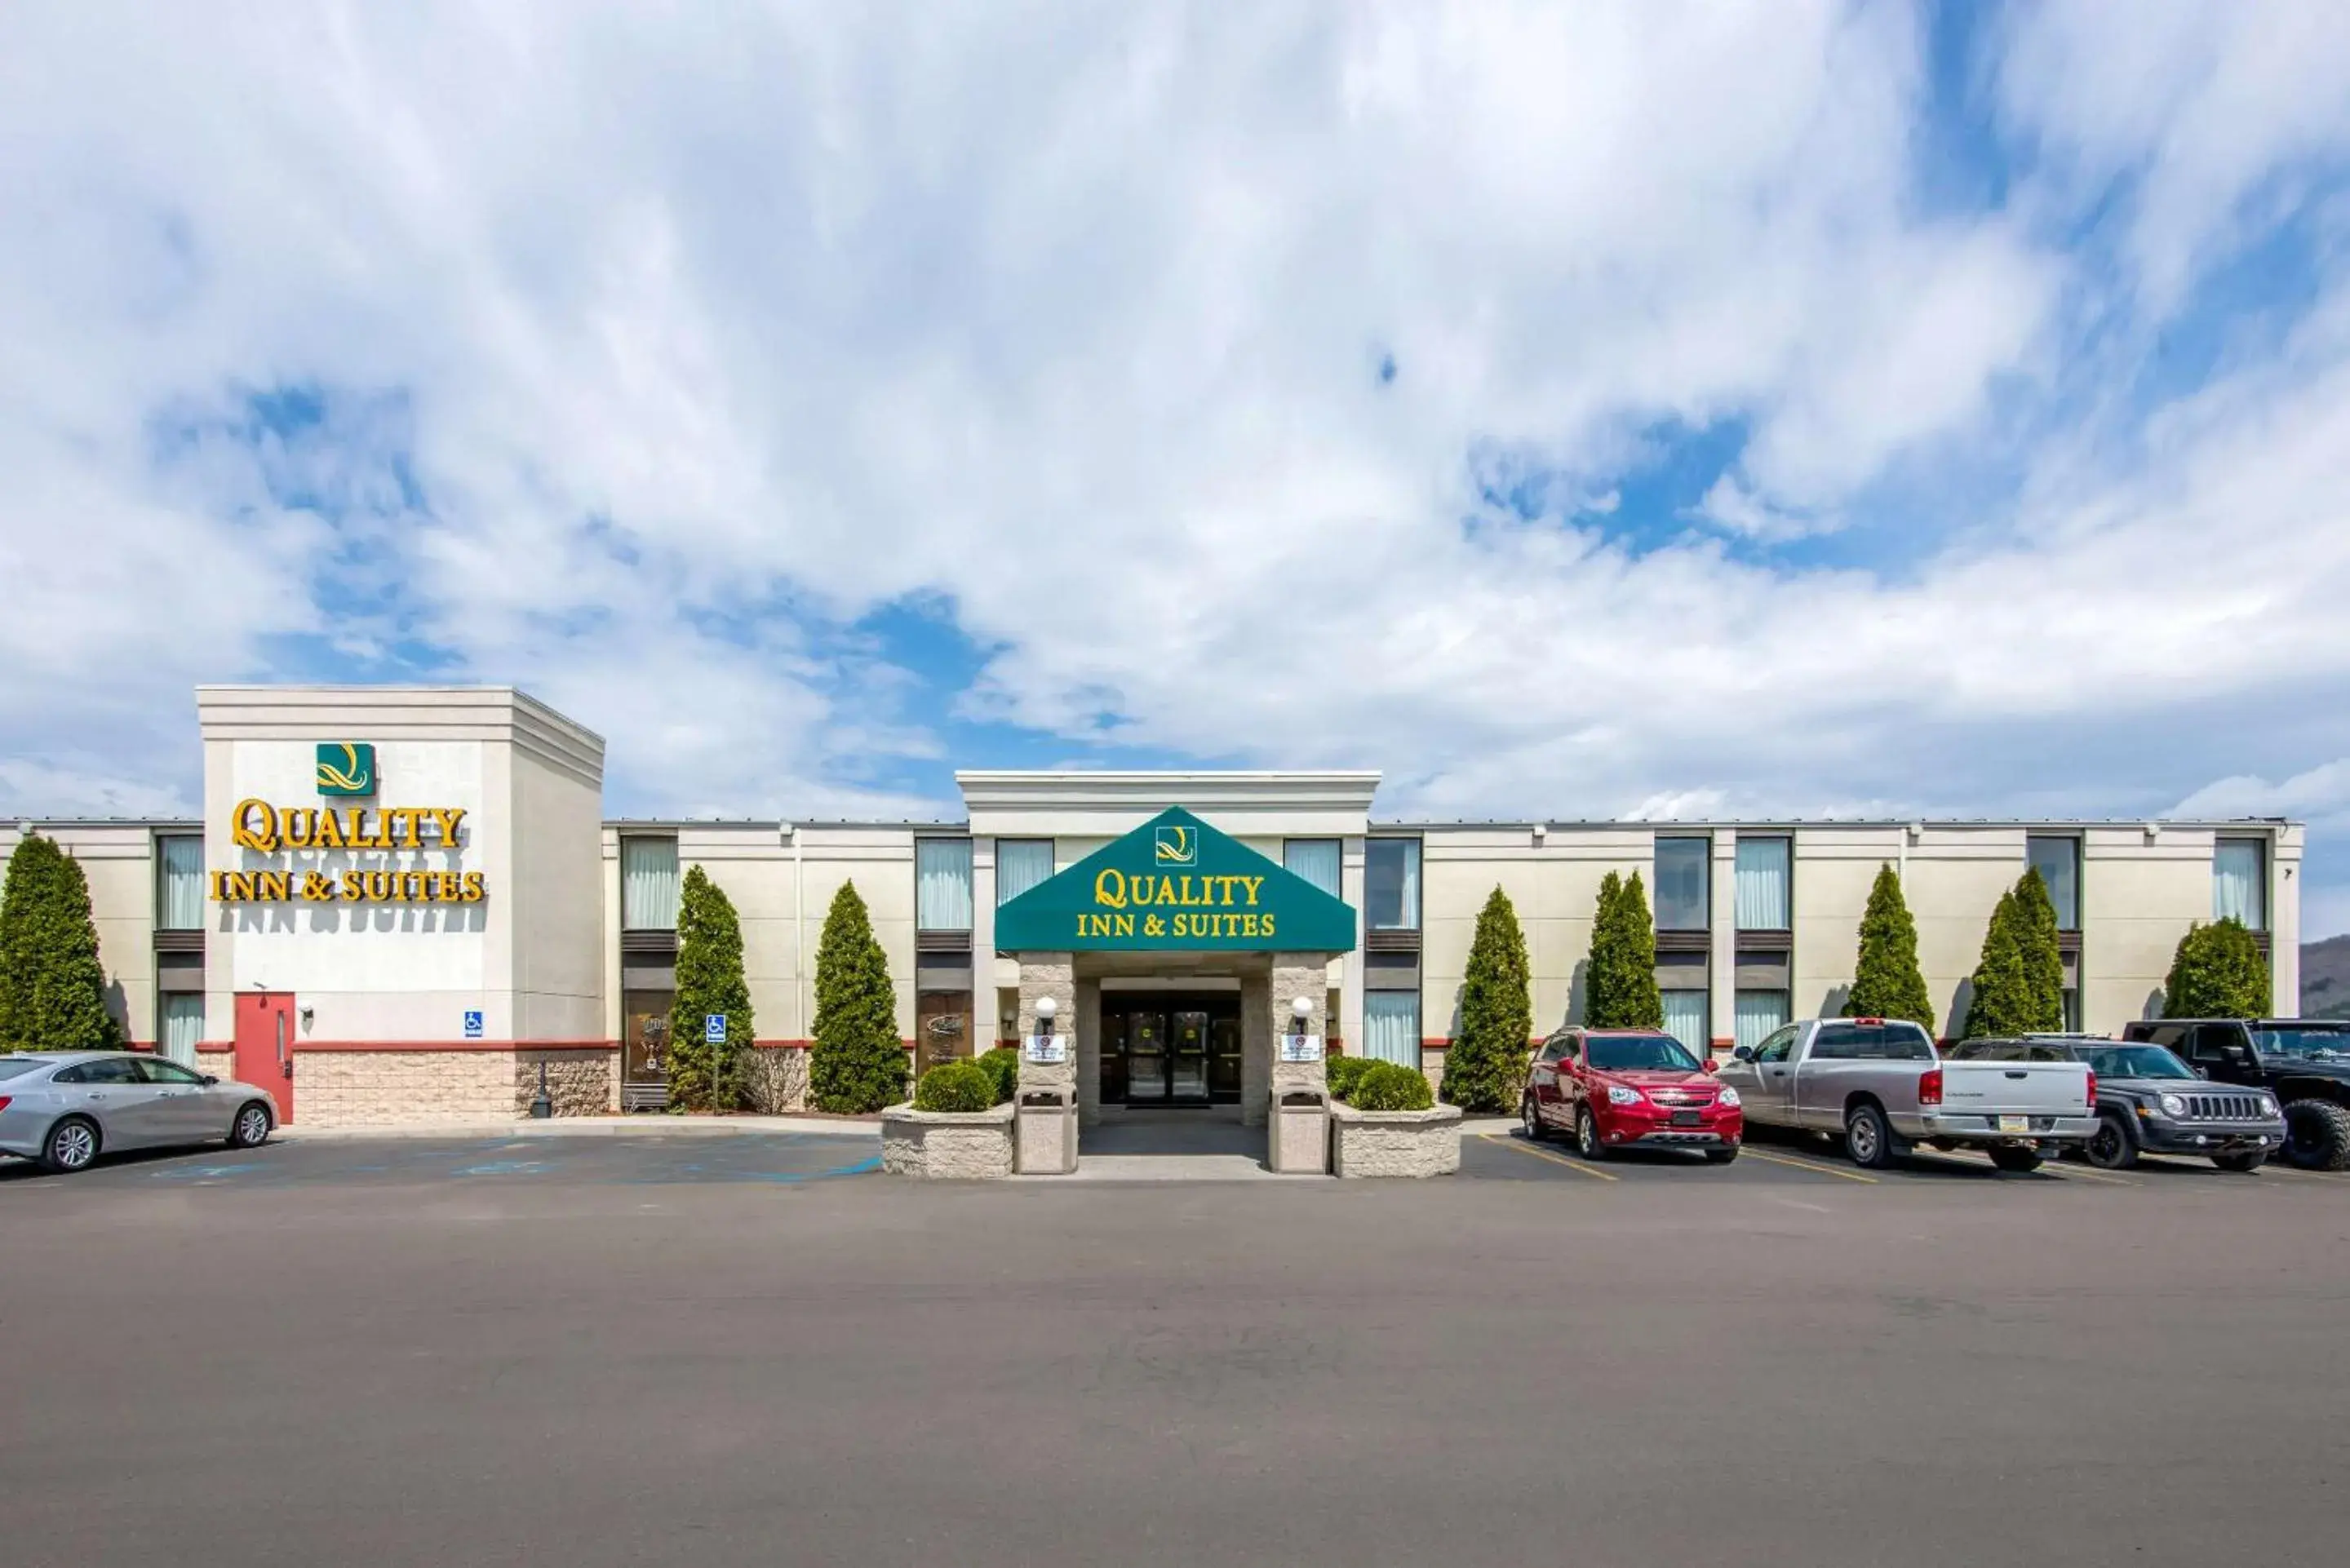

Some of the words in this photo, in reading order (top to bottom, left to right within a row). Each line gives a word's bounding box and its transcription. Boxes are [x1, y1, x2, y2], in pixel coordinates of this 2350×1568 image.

[233, 798, 466, 852] QUALITY
[211, 870, 293, 901] INN
[301, 870, 334, 901] &
[342, 870, 486, 901] SUITES
[1095, 868, 1264, 909] QUALITY
[1077, 914, 1135, 937] INN
[1143, 913, 1165, 937] &
[1173, 913, 1275, 937] SUITES
